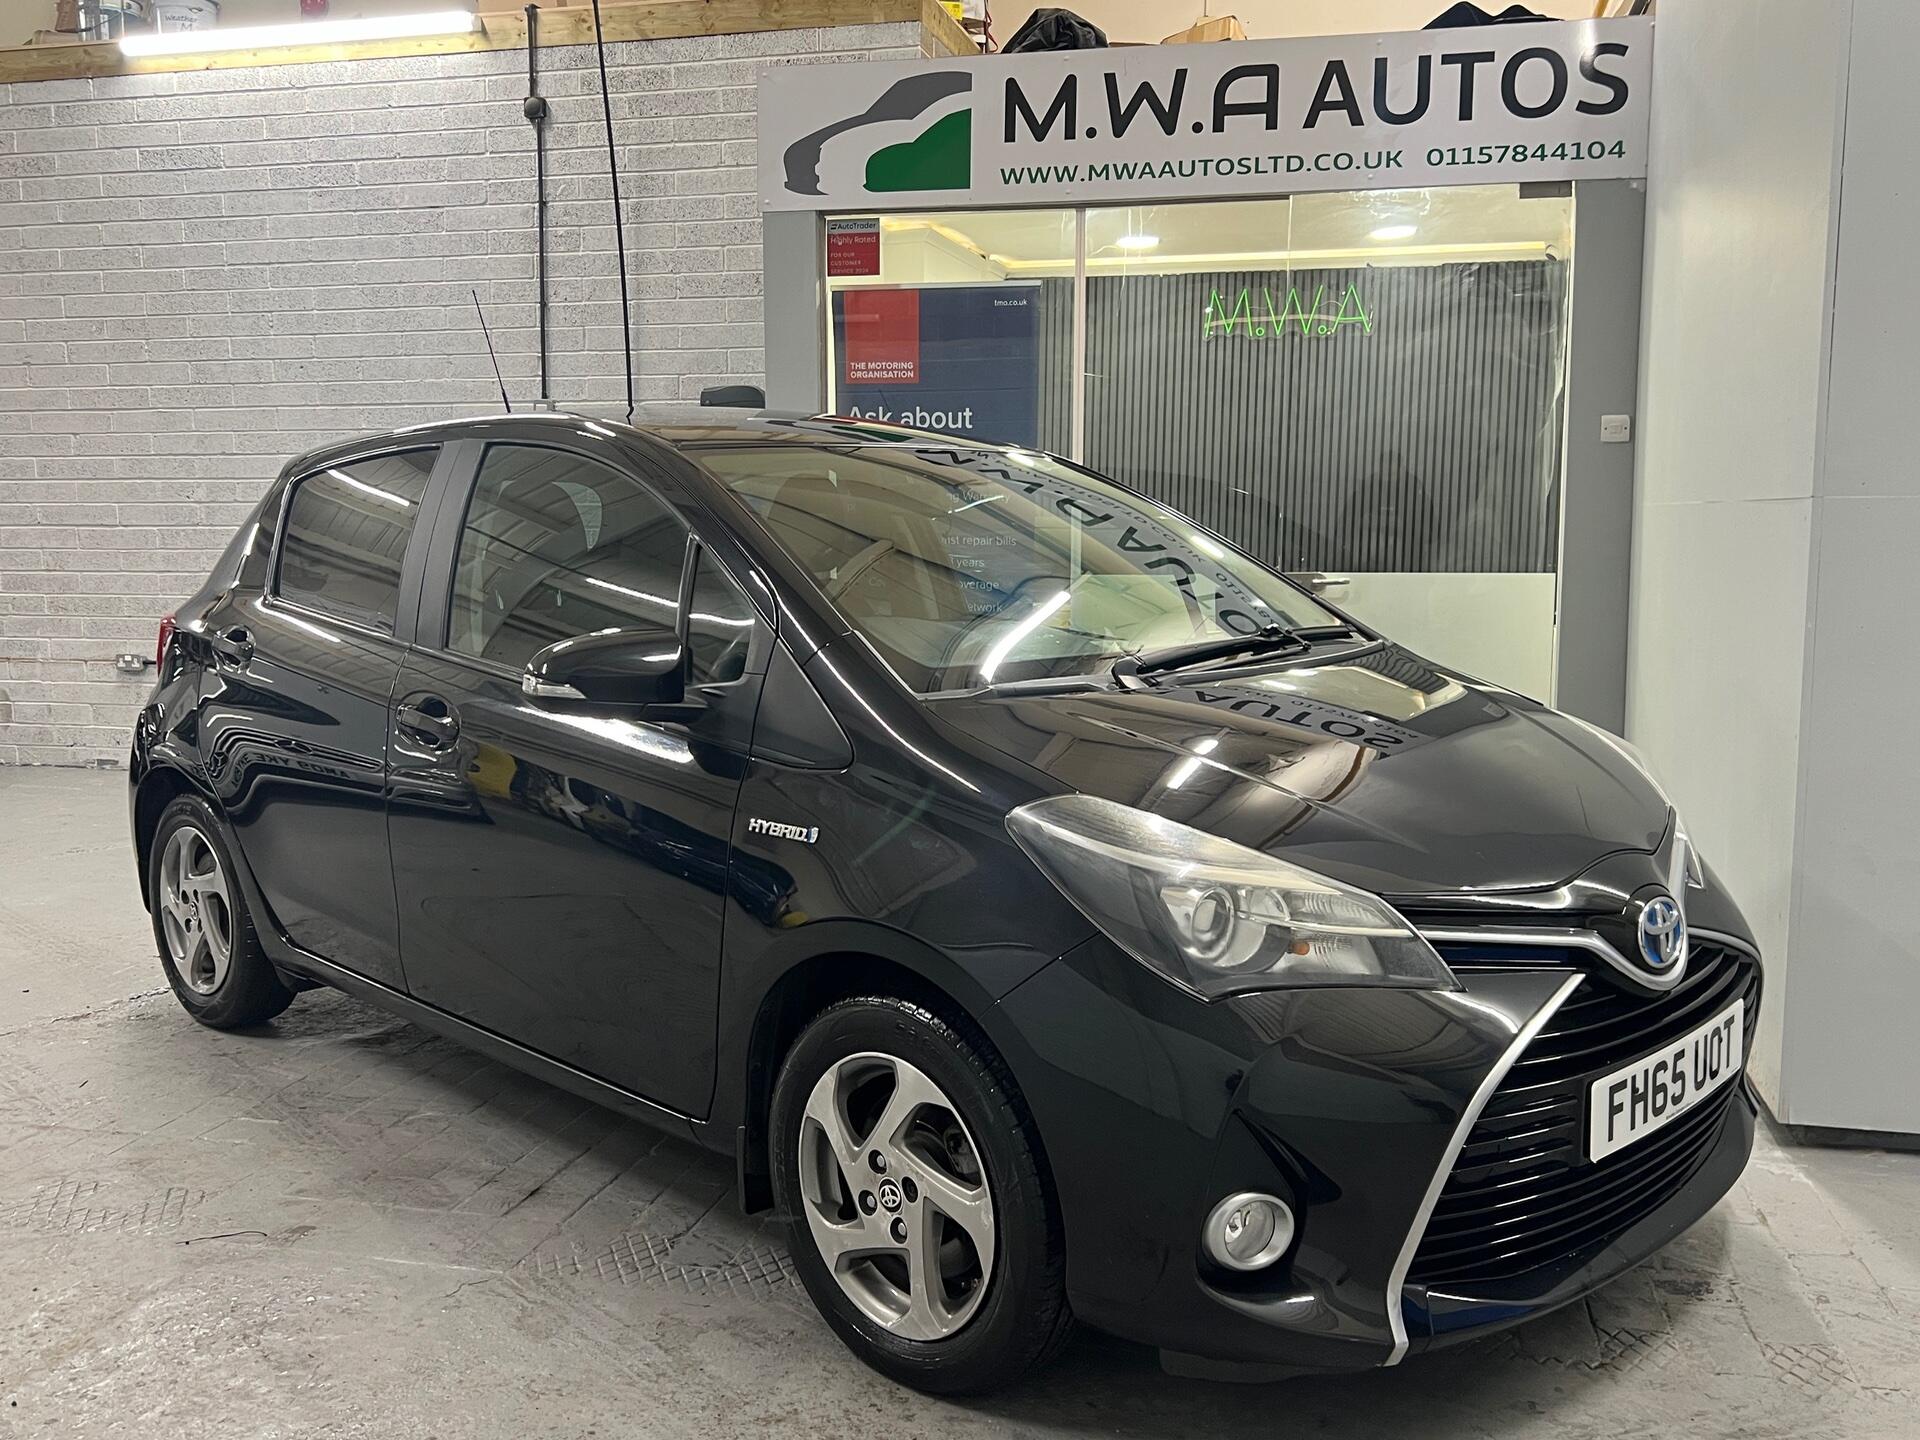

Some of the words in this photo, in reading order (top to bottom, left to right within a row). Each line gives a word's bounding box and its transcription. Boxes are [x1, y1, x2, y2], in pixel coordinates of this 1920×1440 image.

[1003, 63, 1280, 143] M.W.A
[1301, 42, 1630, 129] AUTOS
[1000, 150, 1404, 185] WWW.MWAAUTOSLTD.CO.UK
[1426, 140, 1626, 167] 01157844104
[837, 222, 876, 231] AutoTrader
[830, 235, 853, 246] Highly
[854, 235, 876, 244] Rated
[1204, 283, 1371, 338] M.W.A
[850, 362, 866, 370] THE
[867, 362, 913, 370] MOTORING
[850, 370, 914, 379] ORGANISATION
[900, 406, 973, 429] about
[963, 536, 993, 547] repair
[995, 536, 1017, 546] bills
[960, 580, 1000, 591] overage
[967, 602, 1002, 612] etwork
[748, 818, 808, 842] HYBRID
[1607, 1047, 1687, 1143] FH65
[1694, 1014, 1736, 1092] UOT
